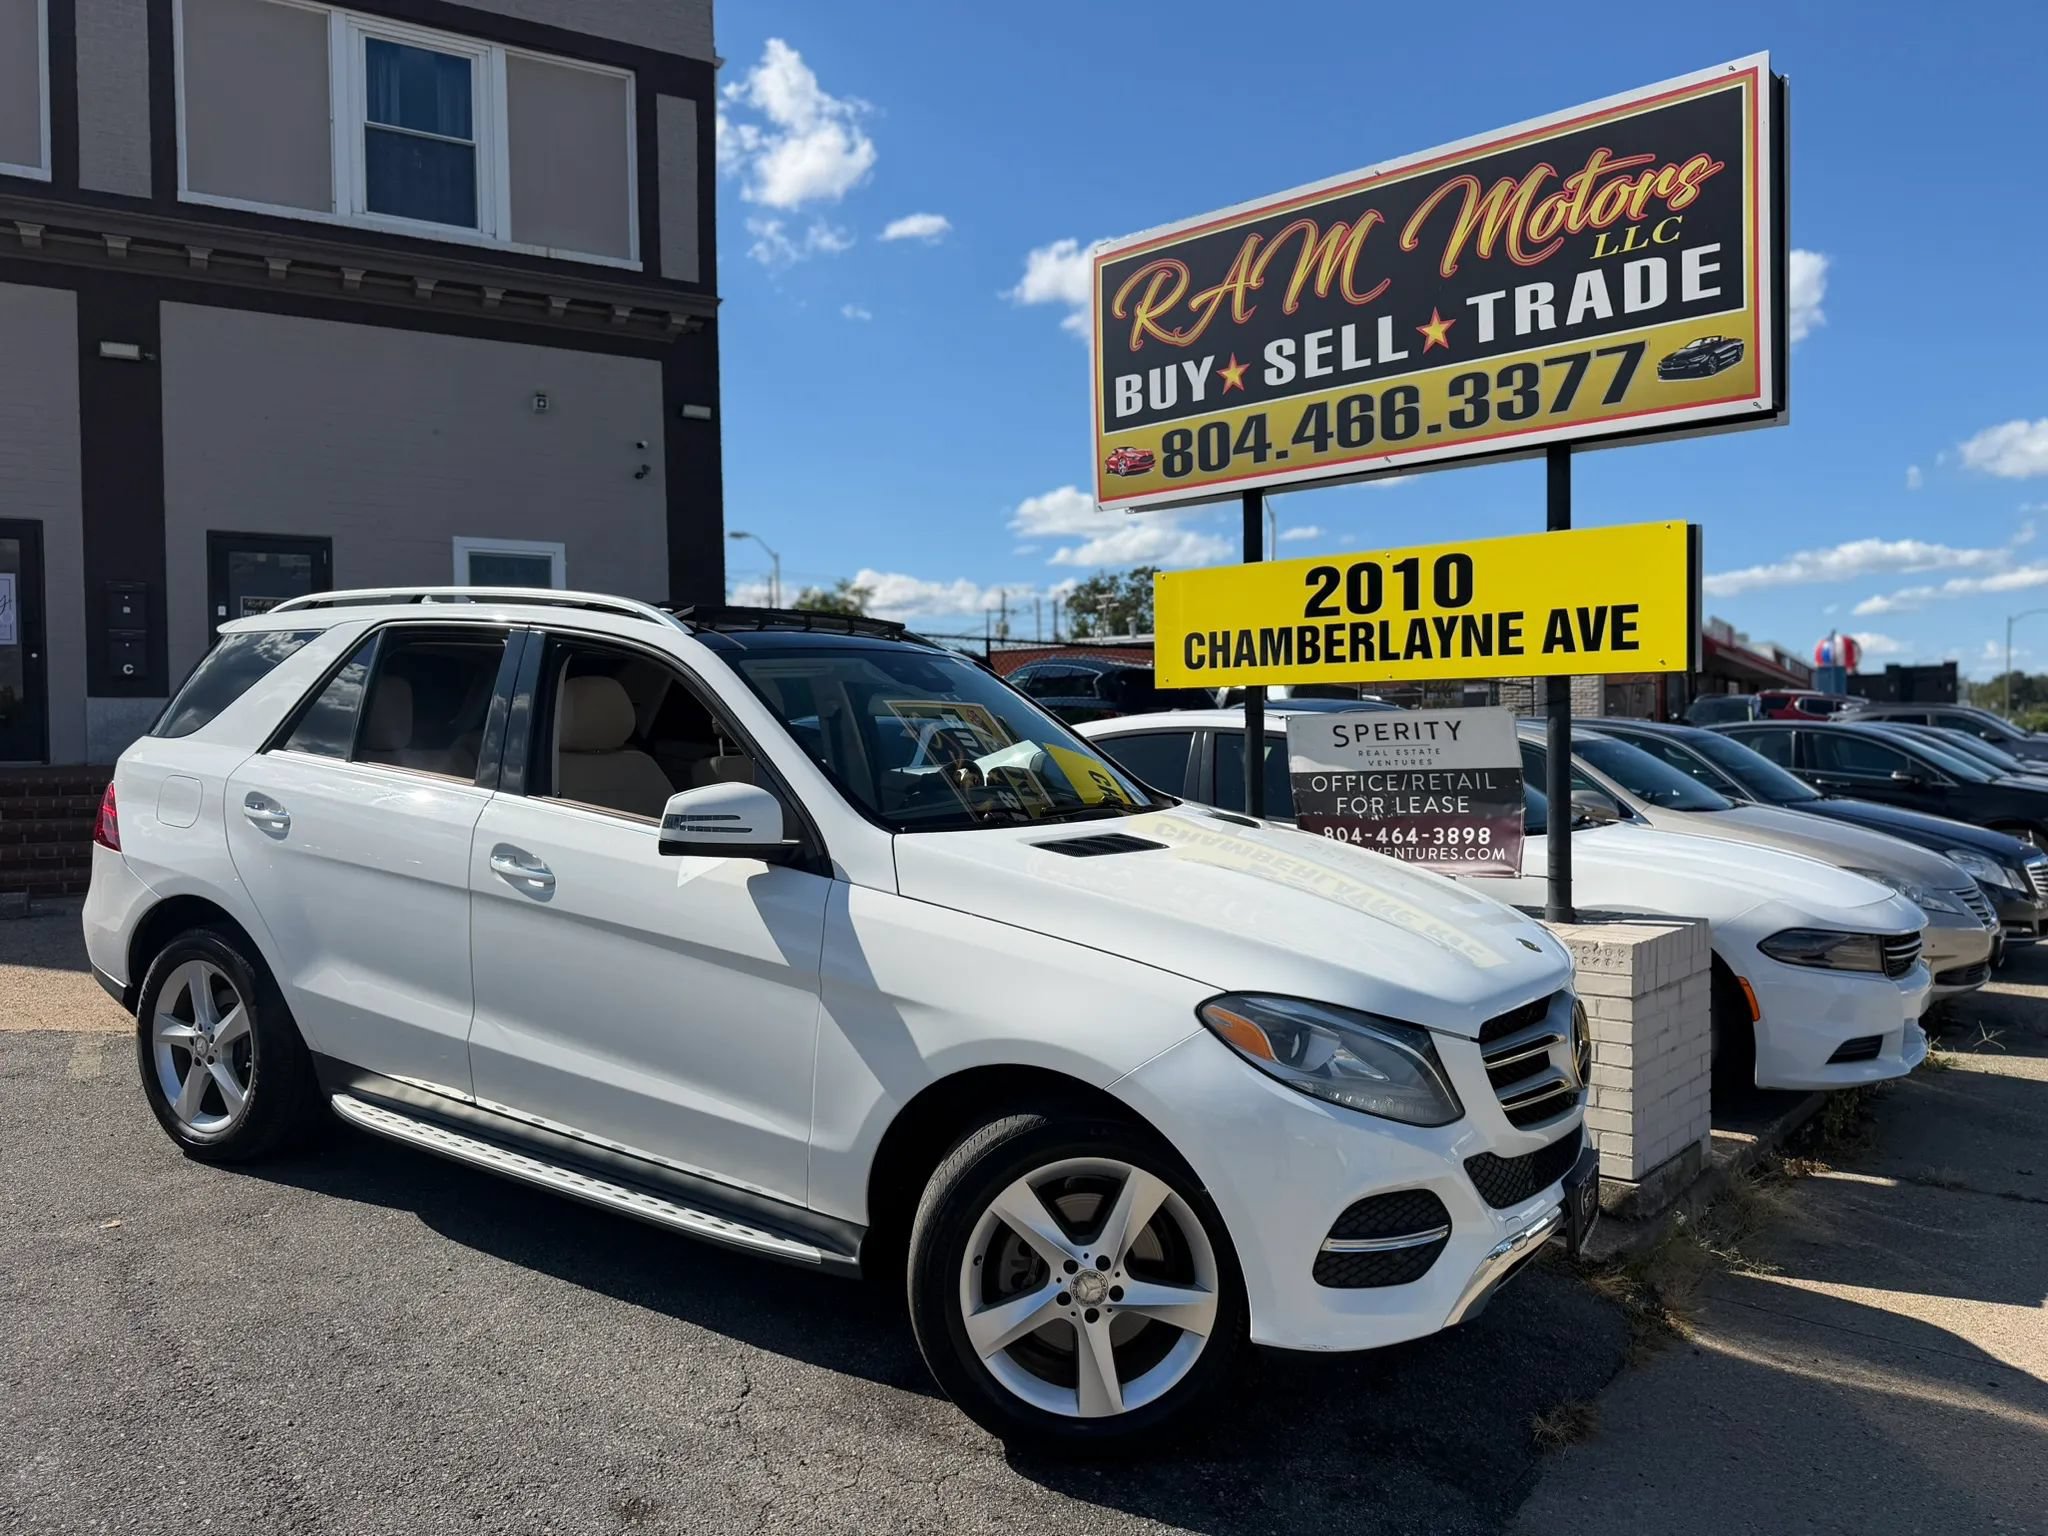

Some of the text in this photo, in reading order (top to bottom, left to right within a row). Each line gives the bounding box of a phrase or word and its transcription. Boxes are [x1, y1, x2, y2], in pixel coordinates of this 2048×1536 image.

[1112, 147, 1724, 352] RAM Motors
[1589, 214, 1683, 260] LLC
[1115, 241, 1722, 419] BUY SELL TRADE
[1161, 339, 1651, 480] 804.466.3377
[1303, 552, 1474, 618] 2010
[1183, 603, 1640, 671] CHAMBERLAYNE AVE
[1332, 720, 1462, 748] SPERITY
[1358, 748, 1441, 757] REAL ESTATE
[1368, 758, 1433, 767] VENTURES
[1311, 772, 1497, 792] OFFICE/RETAIL
[1336, 795, 1470, 815] FOR LEASE
[1323, 826, 1491, 845] 804-464-3898
[1367, 847, 1505, 860] ENTURES.COM
